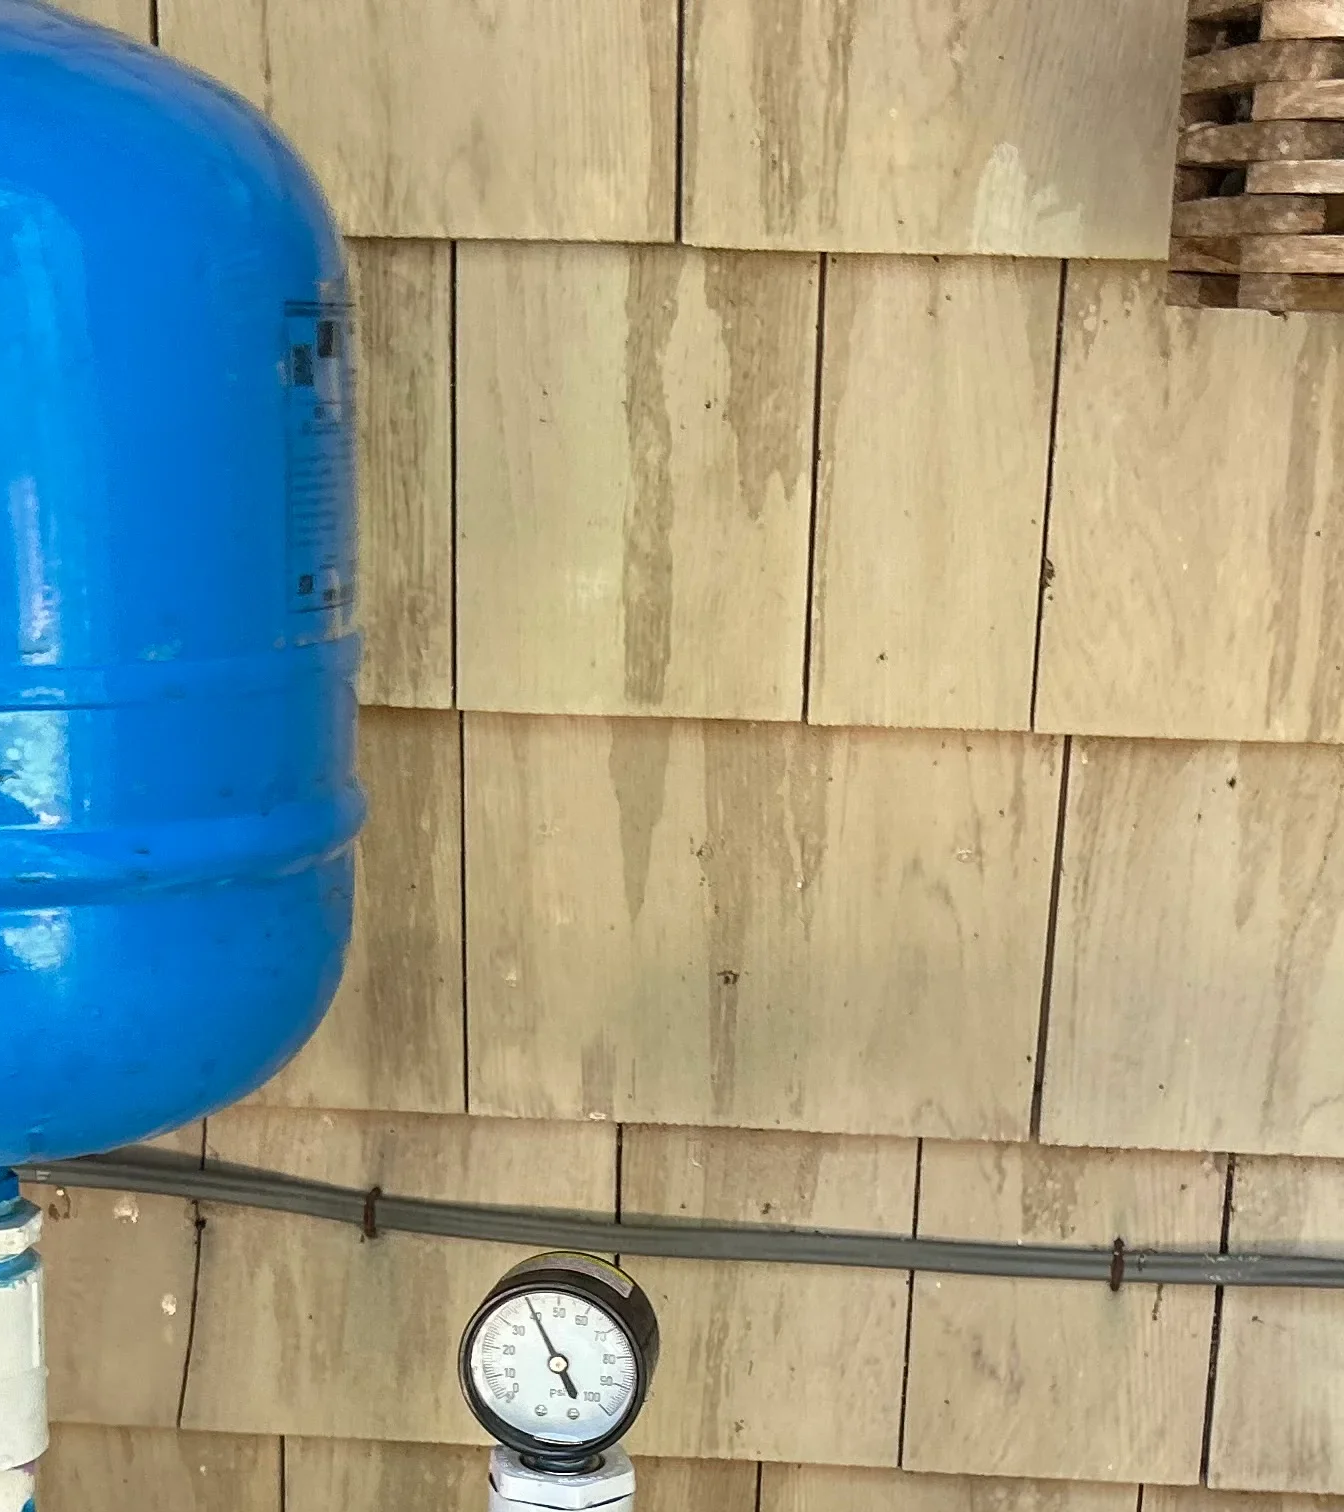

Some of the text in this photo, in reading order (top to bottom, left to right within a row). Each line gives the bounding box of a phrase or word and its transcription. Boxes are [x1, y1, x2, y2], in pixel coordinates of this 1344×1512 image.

[552, 1306, 567, 1319] 50
[574, 1315, 589, 1327] 60
[511, 1324, 526, 1337] 30
[502, 1344, 516, 1356] 20
[602, 1354, 617, 1365] 80
[504, 1367, 516, 1379] 10
[583, 1391, 601, 1403] 100
